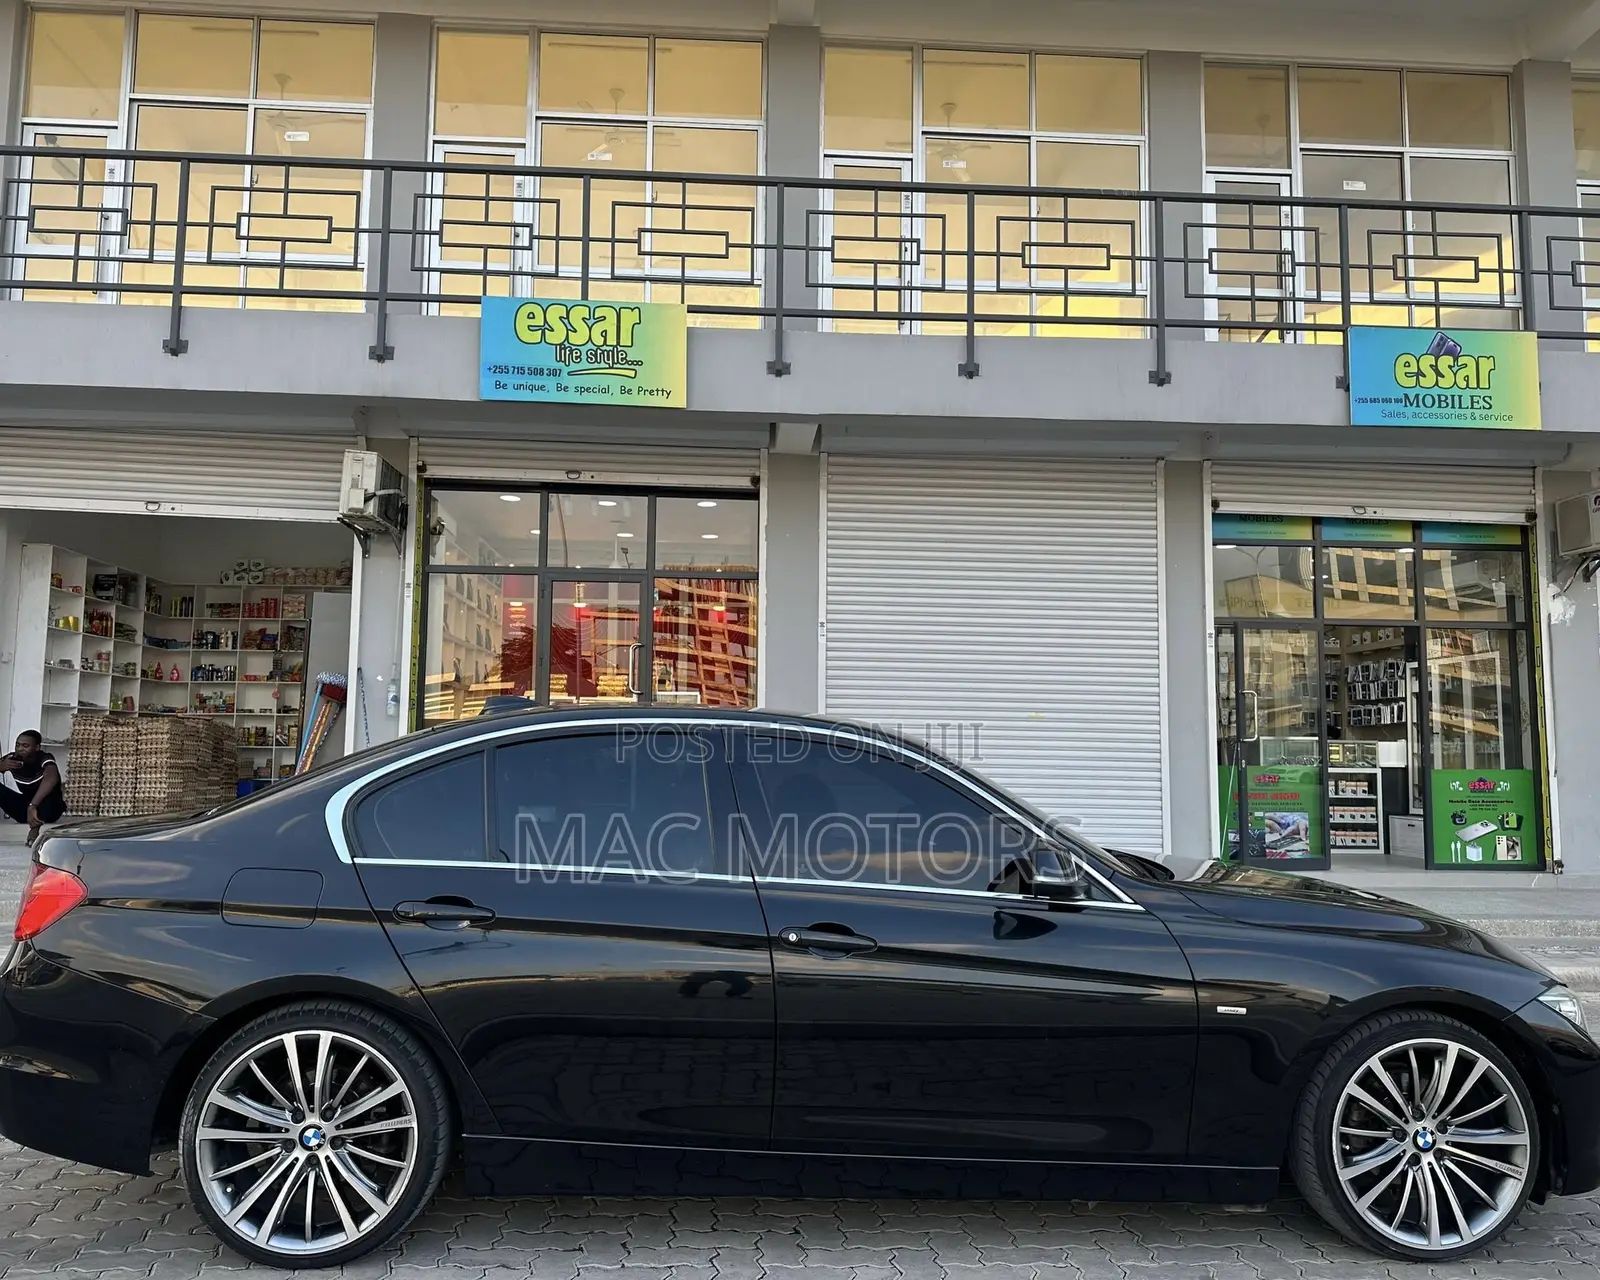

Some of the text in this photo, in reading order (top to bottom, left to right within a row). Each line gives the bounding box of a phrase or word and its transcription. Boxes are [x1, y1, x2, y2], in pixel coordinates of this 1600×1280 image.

[514, 302, 641, 347] essar
[555, 345, 581, 366] life
[487, 365, 562, 377] +255 715 508 307
[1394, 353, 1495, 389] essar
[494, 380, 671, 399] Be unique, Be special, Be Pretty
[1403, 393, 1492, 410] MOBILES
[1381, 409, 1513, 422] Sales, accessories & service
[1468, 780, 1497, 790] essar
